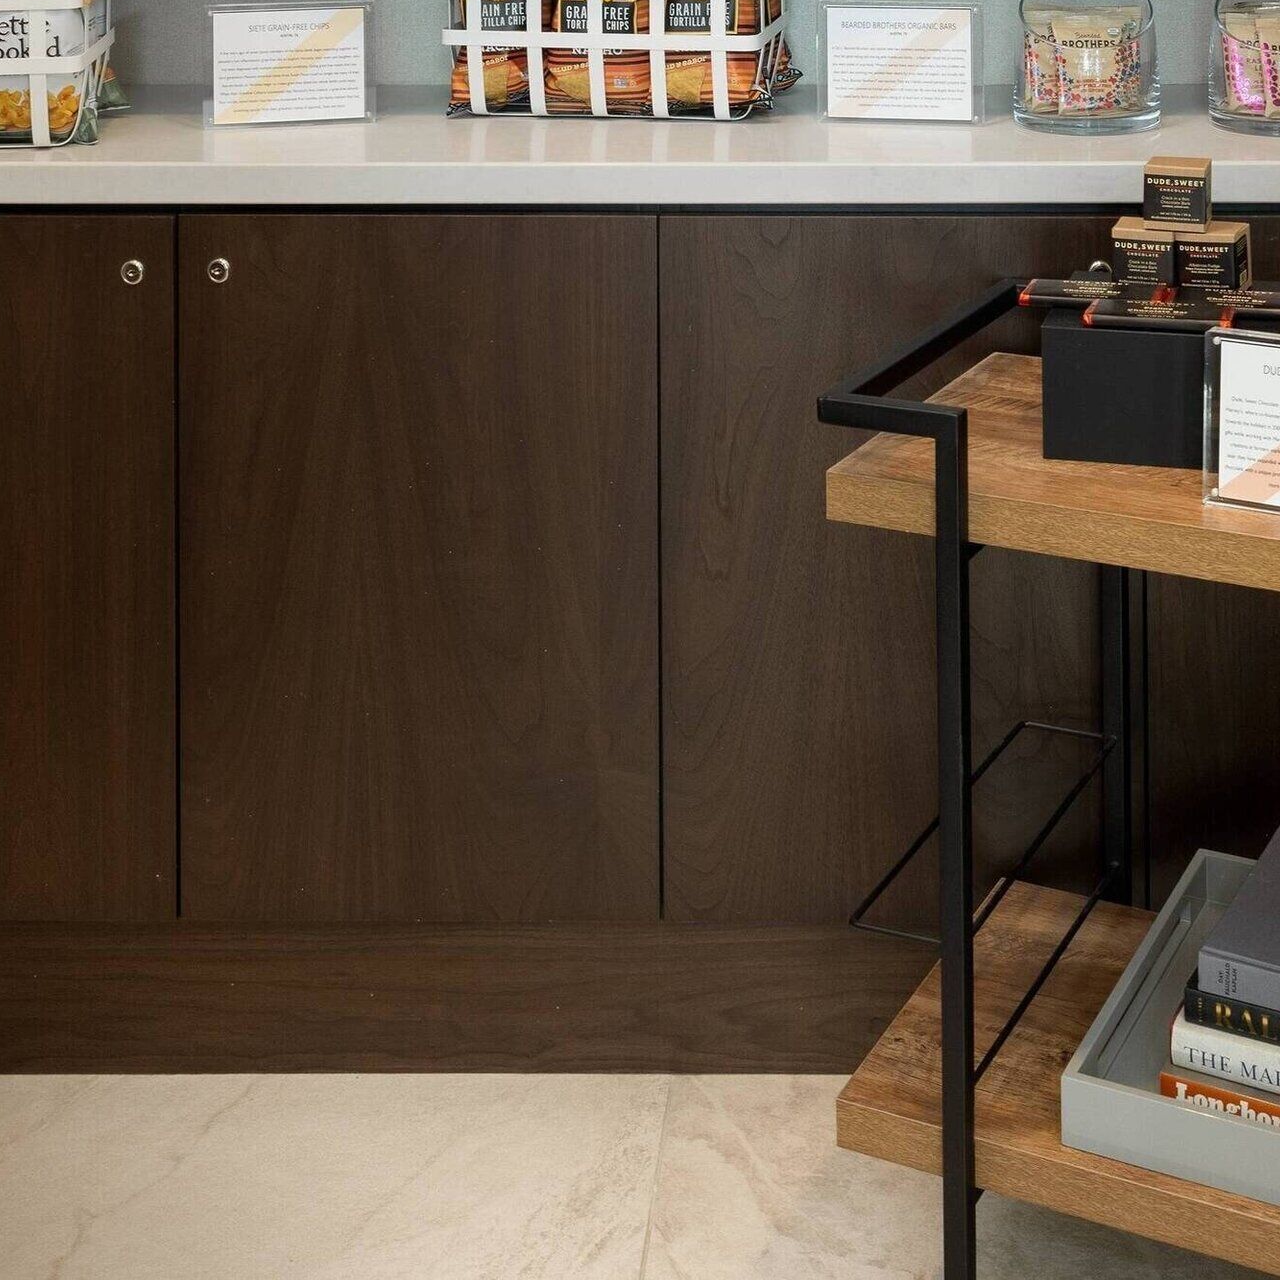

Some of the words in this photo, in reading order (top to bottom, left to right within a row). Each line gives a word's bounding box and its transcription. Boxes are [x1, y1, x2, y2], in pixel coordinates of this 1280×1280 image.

[482, 3, 501, 17] AIN
[505, 1, 525, 16] FRE
[565, 5, 587, 19] GRA
[603, 6, 630, 20] FREE
[669, 2, 703, 17] GRAIN
[482, 16, 506, 28] TILLA
[507, 15, 527, 26] CHIP
[566, 20, 587, 30] TORT
[606, 20, 630, 31] CHIPS
[669, 16, 707, 27] TORTILLA
[841, 21, 871, 30] BEARDED
[872, 21, 907, 30] BROTHERS
[907, 22, 938, 31] ORGANIC
[939, 22, 957, 31] BARS
[248, 24, 267, 33] SIETE
[267, 23, 309, 32] GRAIN-FREE
[309, 22, 330, 31] CHIPS
[1061, 39, 1117, 49] BROTHERS
[1127, 251, 1159, 259] CHOCOLATE
[1184, 1046, 1232, 1074] THE
